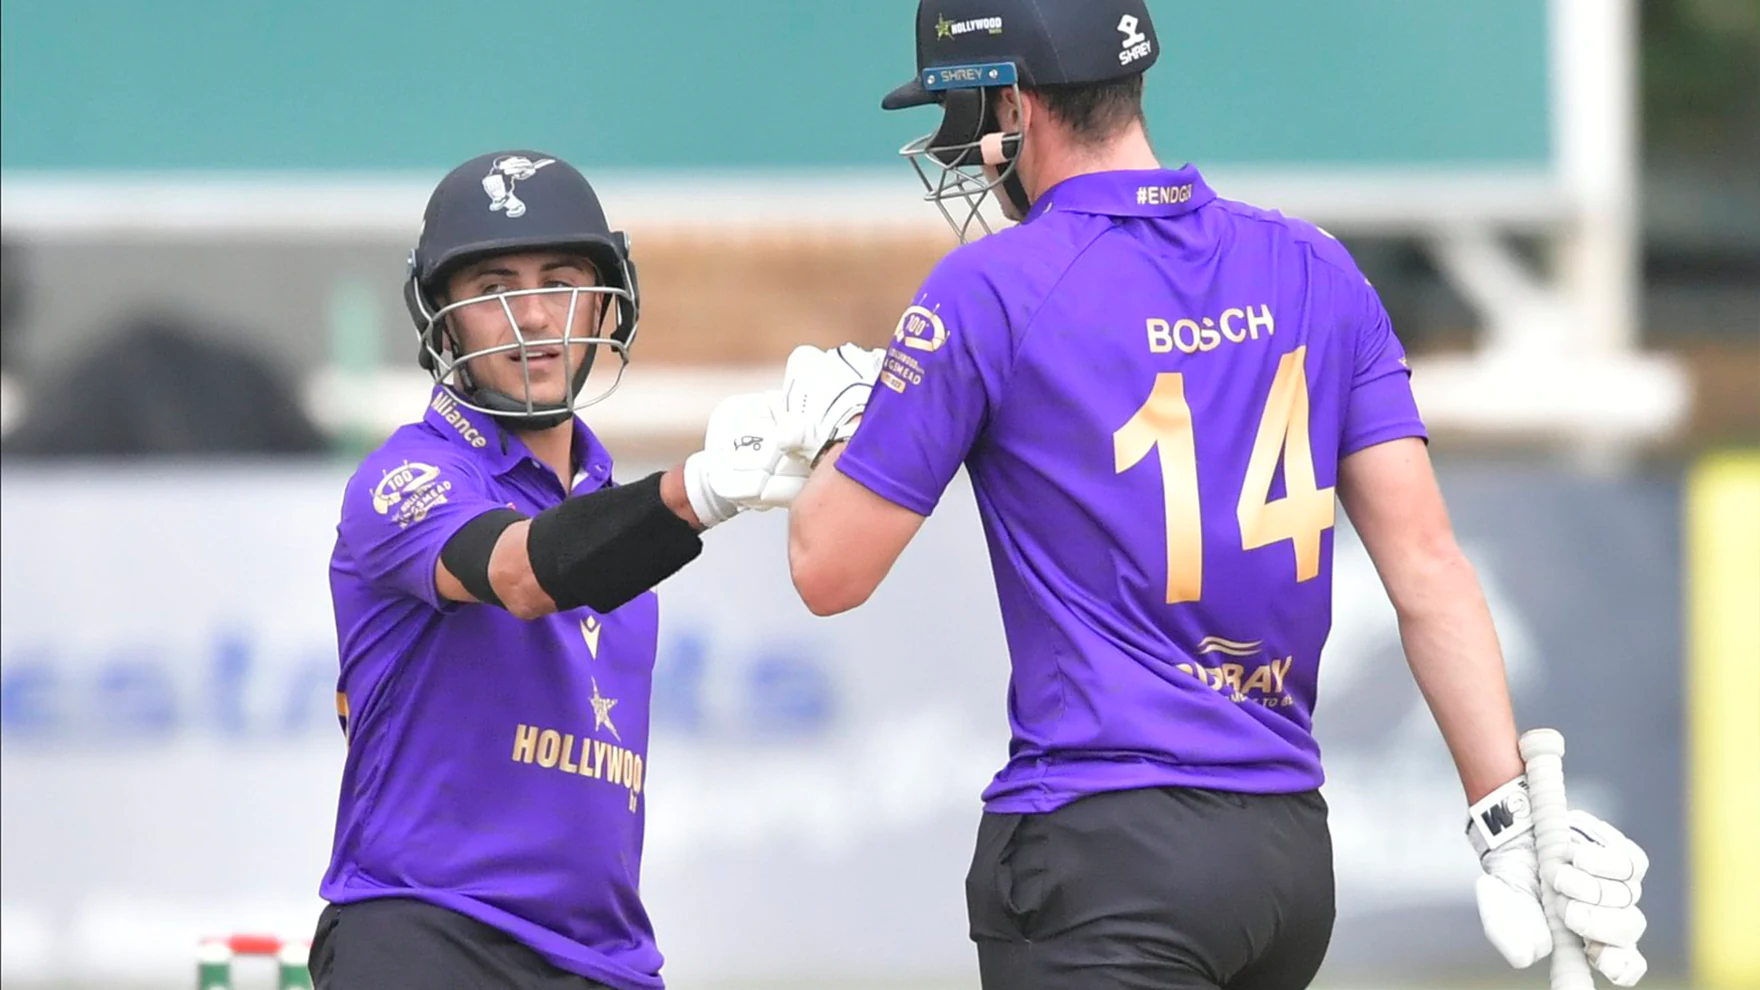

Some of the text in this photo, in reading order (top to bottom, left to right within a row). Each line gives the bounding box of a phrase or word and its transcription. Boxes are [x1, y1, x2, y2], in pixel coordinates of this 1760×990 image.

[951, 17, 1002, 35] HOLLYWOOD
[1119, 40, 1152, 66] SHREY
[941, 68, 984, 82] SHREY
[1146, 304, 1275, 354] BOSCH
[388, 470, 414, 492] 100
[1113, 344, 1335, 605] 14
